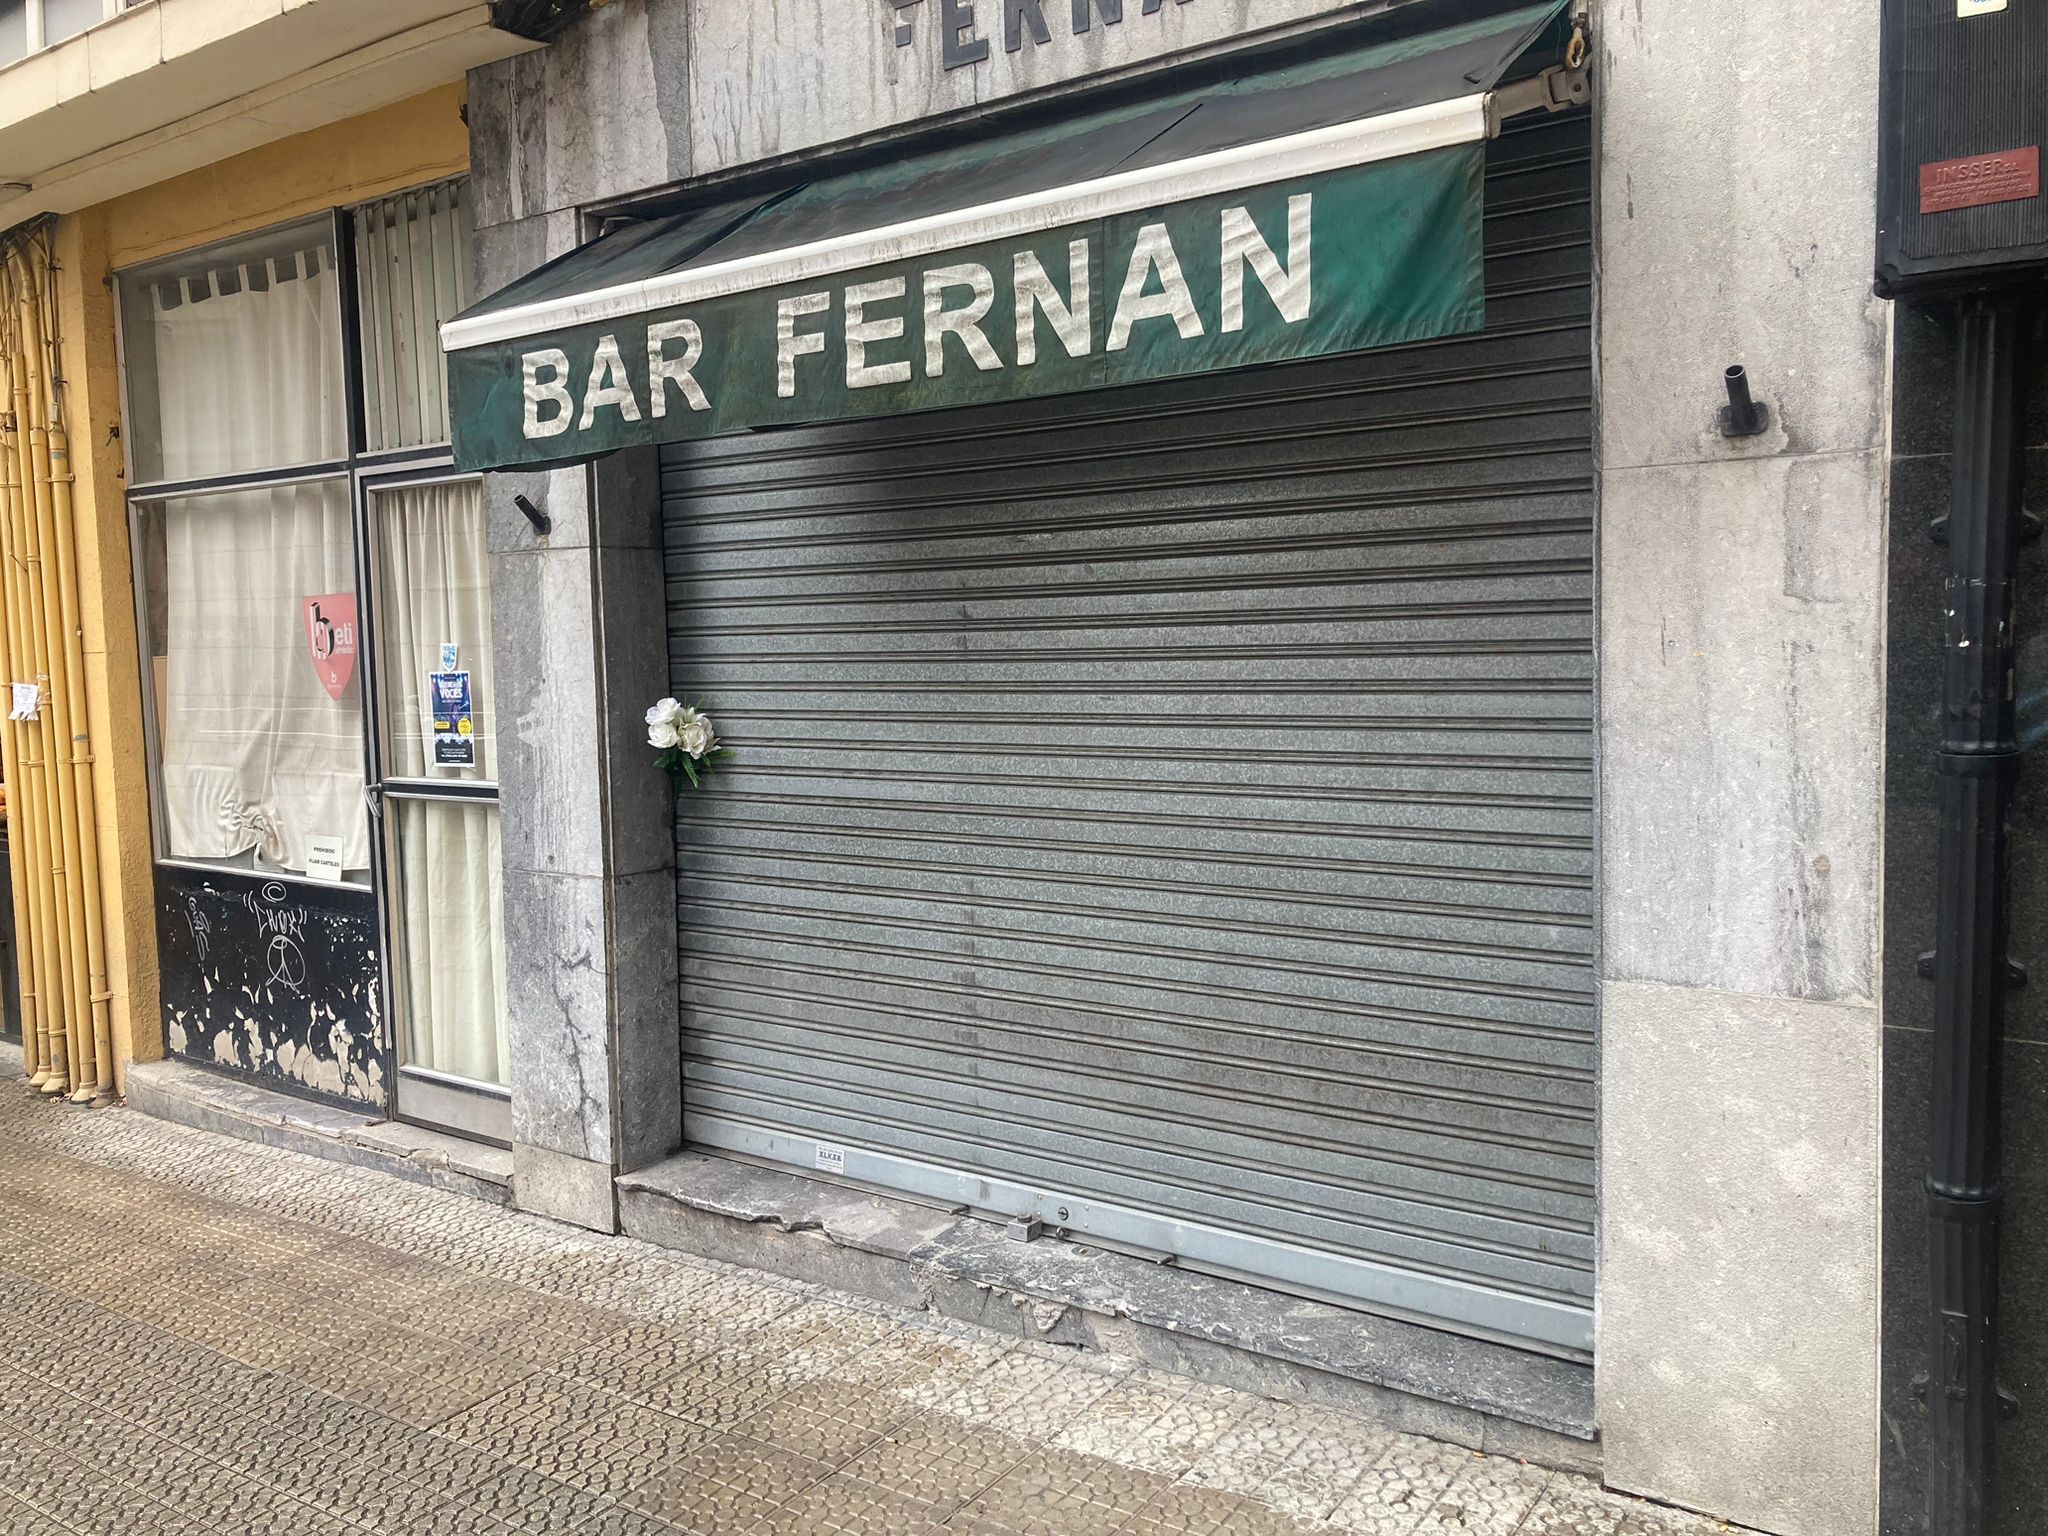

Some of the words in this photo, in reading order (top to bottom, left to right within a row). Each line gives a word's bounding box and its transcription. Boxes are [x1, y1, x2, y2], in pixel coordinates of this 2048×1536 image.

[1936, 158, 2003, 184] INSSER
[521, 318, 712, 439] BAR
[777, 193, 1313, 398] FERNAN
[439, 688, 463, 699] VOCES
